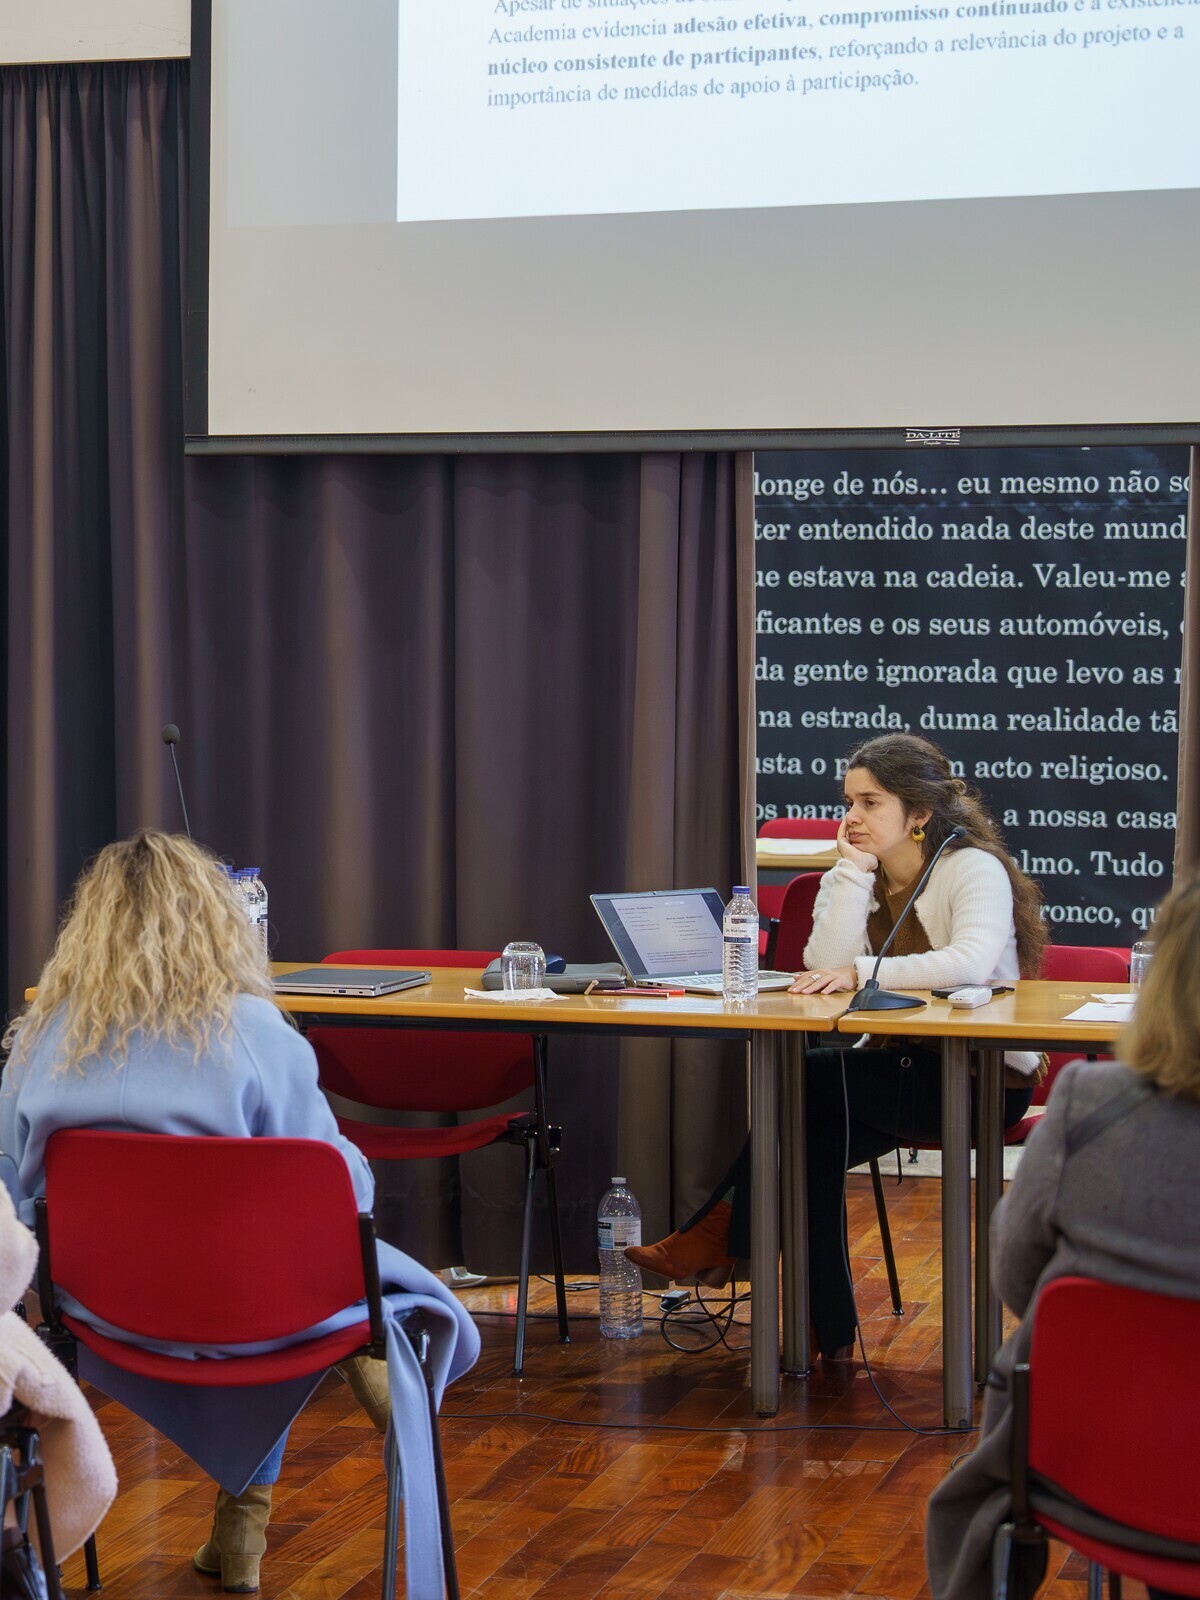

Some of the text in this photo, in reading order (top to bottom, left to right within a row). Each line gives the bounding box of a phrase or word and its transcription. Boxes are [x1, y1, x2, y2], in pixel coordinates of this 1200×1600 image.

[489, 22, 576, 44] Academia
[582, 18, 667, 39] evidencia
[673, 15, 738, 35] adesão
[743, 12, 814, 30] efetiva,
[819, 3, 949, 28] compromisso
[956, 0, 1068, 19] continuado
[1074, 0, 1085, 12] e
[1091, 0, 1100, 10] a
[488, 24, 1185, 76] núcleo consistente de participantes, reforçando a relevância do projeto e a
[487, 69, 919, 109] importância de medidas de apoio à participação.
[754, 472, 825, 500] longe
[833, 470, 864, 495] de
[872, 470, 947, 495] nós...
[957, 477, 991, 495] eu
[999, 476, 1099, 494] mesmo
[1108, 470, 1160, 494] não
[754, 515, 1186, 541] ter entendido nada deste mund
[788, 565, 876, 588] estava
[884, 570, 918, 588] na
[926, 563, 1023, 588] cadeia.
[1032, 563, 1170, 588] Valeu-me
[756, 610, 861, 634] ficantes
[870, 617, 883, 634] e
[892, 618, 920, 635] os
[929, 618, 990, 636] seus
[999, 611, 1169, 640] automóveis,
[755, 657, 784, 681] da
[793, 659, 869, 687] gente
[876, 657, 998, 688] ignorada
[1007, 666, 1058, 689] que
[1066, 659, 1124, 684] levo
[1132, 667, 1164, 685] as
[758, 710, 793, 728] na
[800, 706, 911, 732] estrada,
[919, 706, 998, 731] duma
[1007, 706, 1141, 733] realidade
[811, 757, 827, 775] o
[974, 756, 1032, 779] acto
[1040, 754, 1168, 785] religioso.
[785, 804, 847, 821] para
[1003, 809, 1019, 827] a
[1028, 809, 1108, 828] nossa
[1117, 810, 1176, 829] casa
[1090, 850, 1164, 877] Tudo
